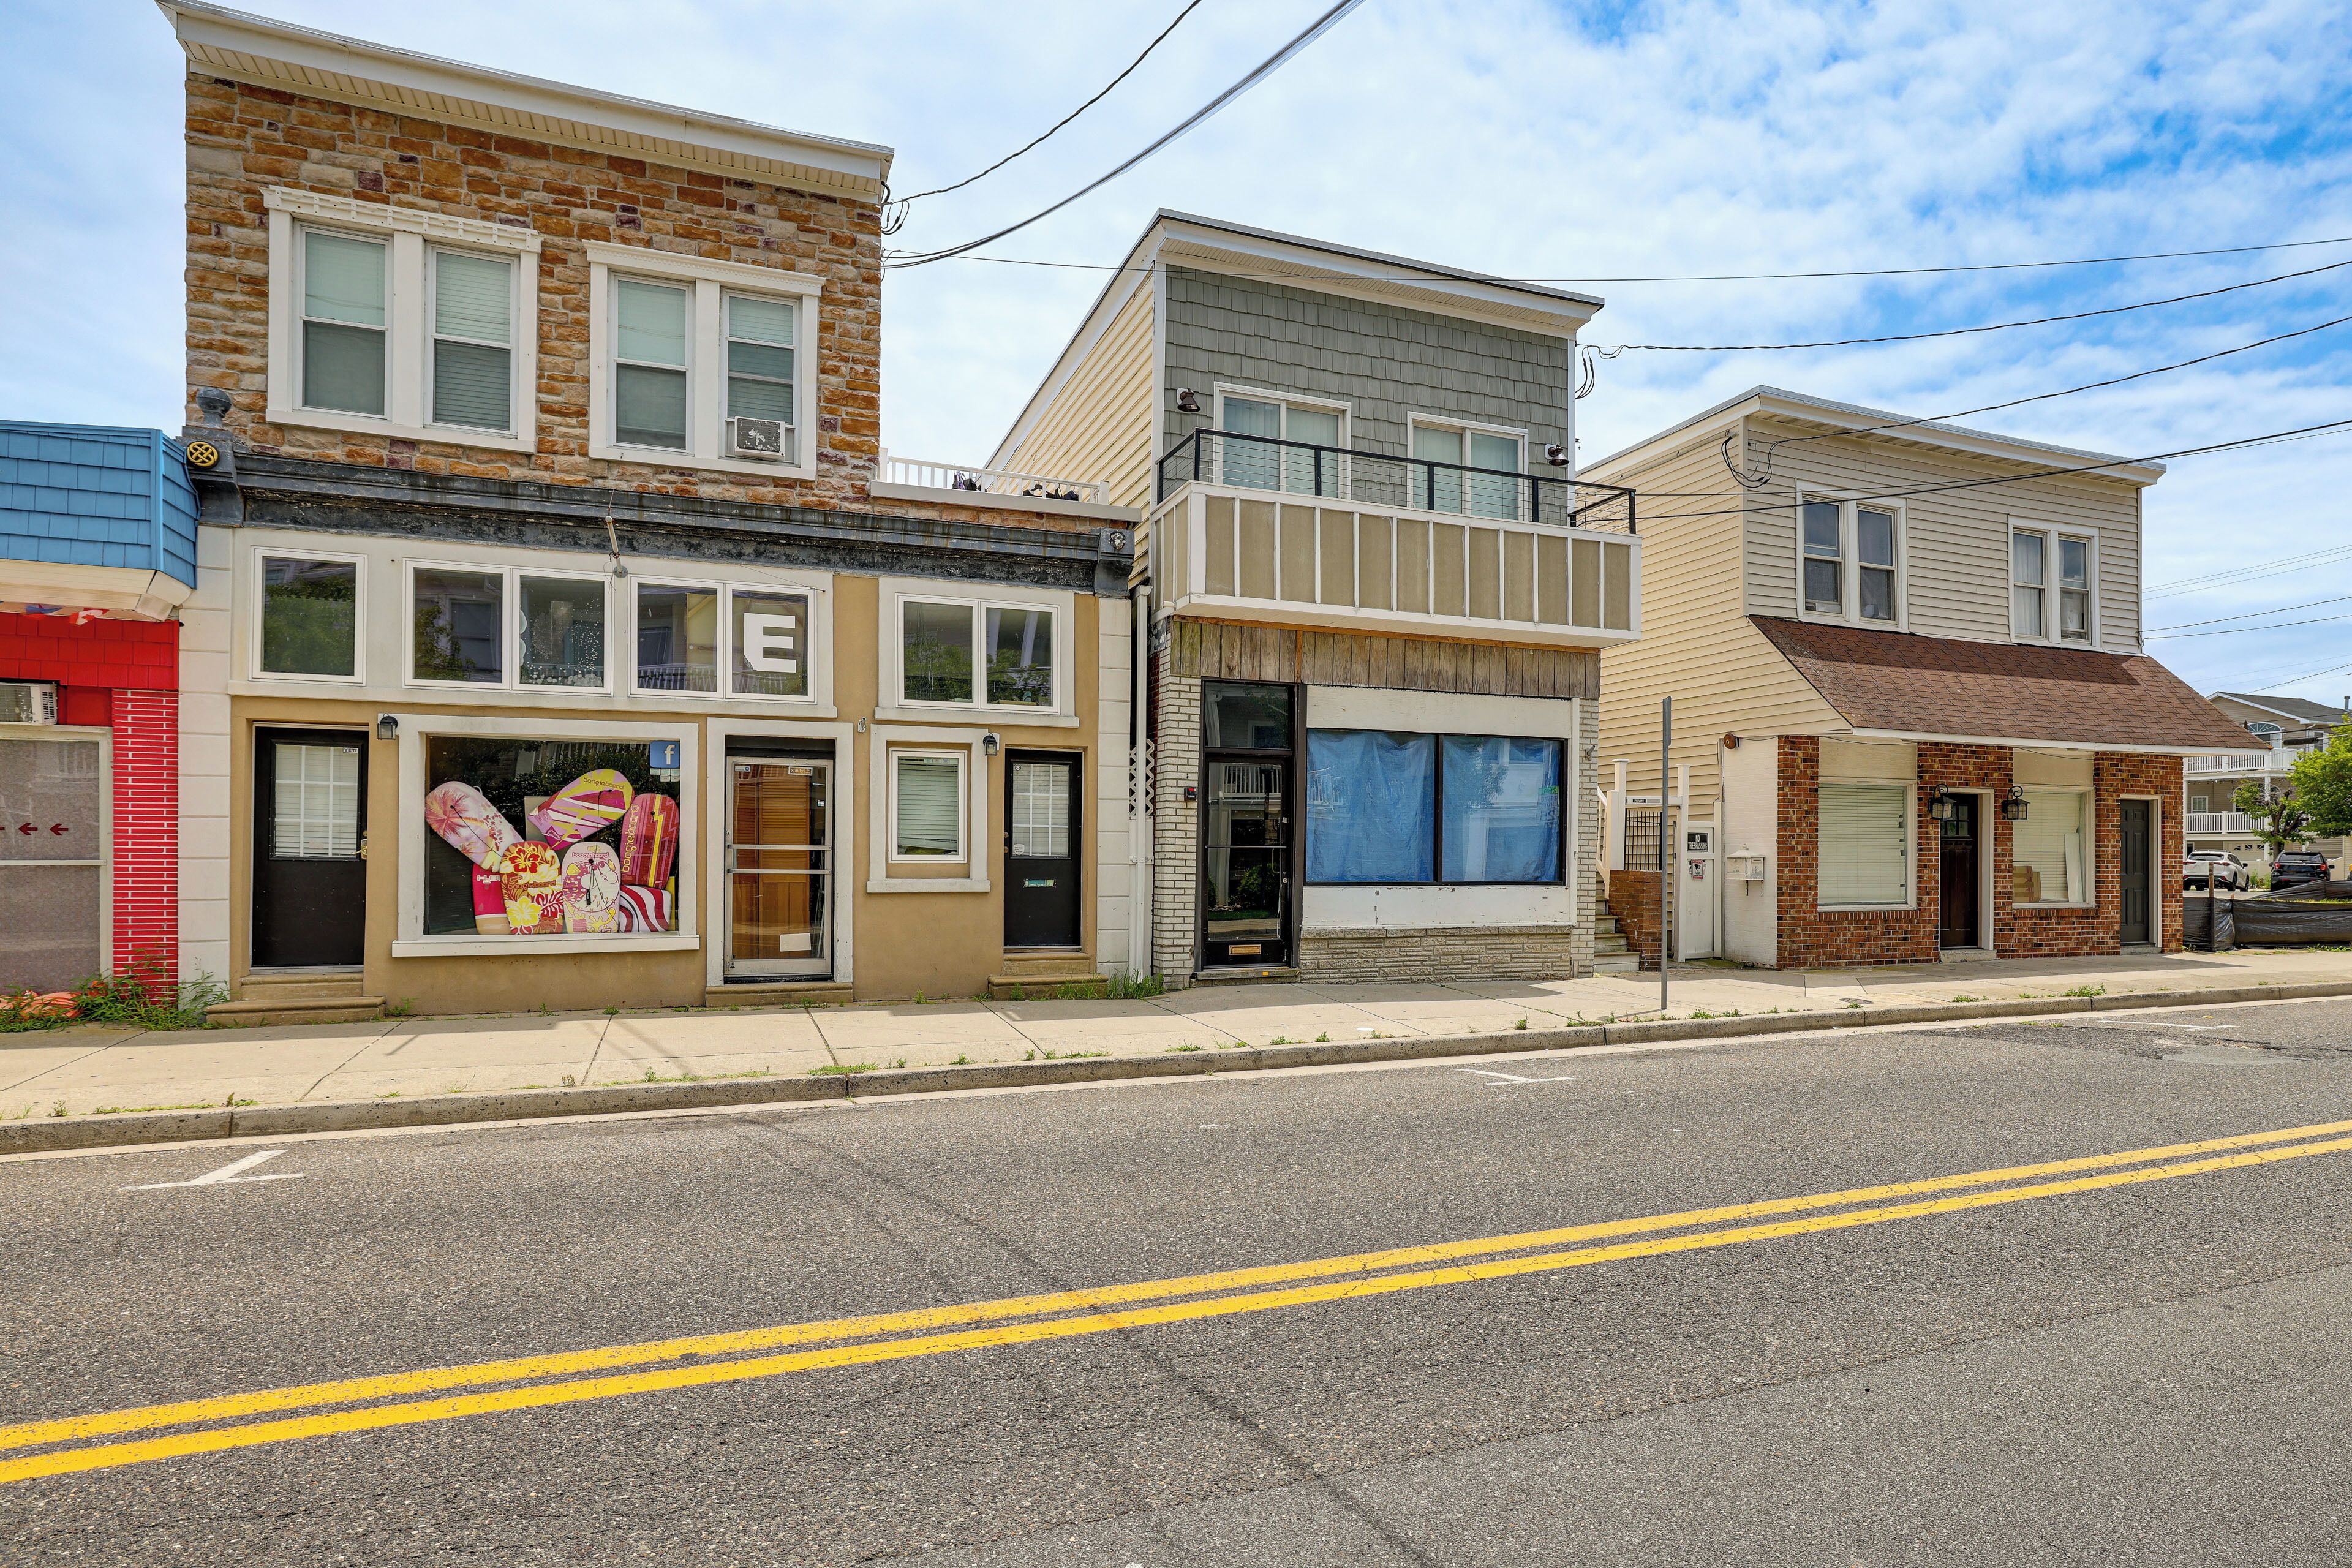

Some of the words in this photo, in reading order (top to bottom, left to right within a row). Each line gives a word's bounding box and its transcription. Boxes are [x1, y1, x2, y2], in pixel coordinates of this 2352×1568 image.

[744, 612, 796, 673] E
[664, 744, 675, 765] f
[583, 777, 625, 790] boogieboard
[1688, 842, 1708, 850] TRESPASSING
[572, 851, 609, 860] boogieboard
[508, 880, 556, 891] boogieboard
